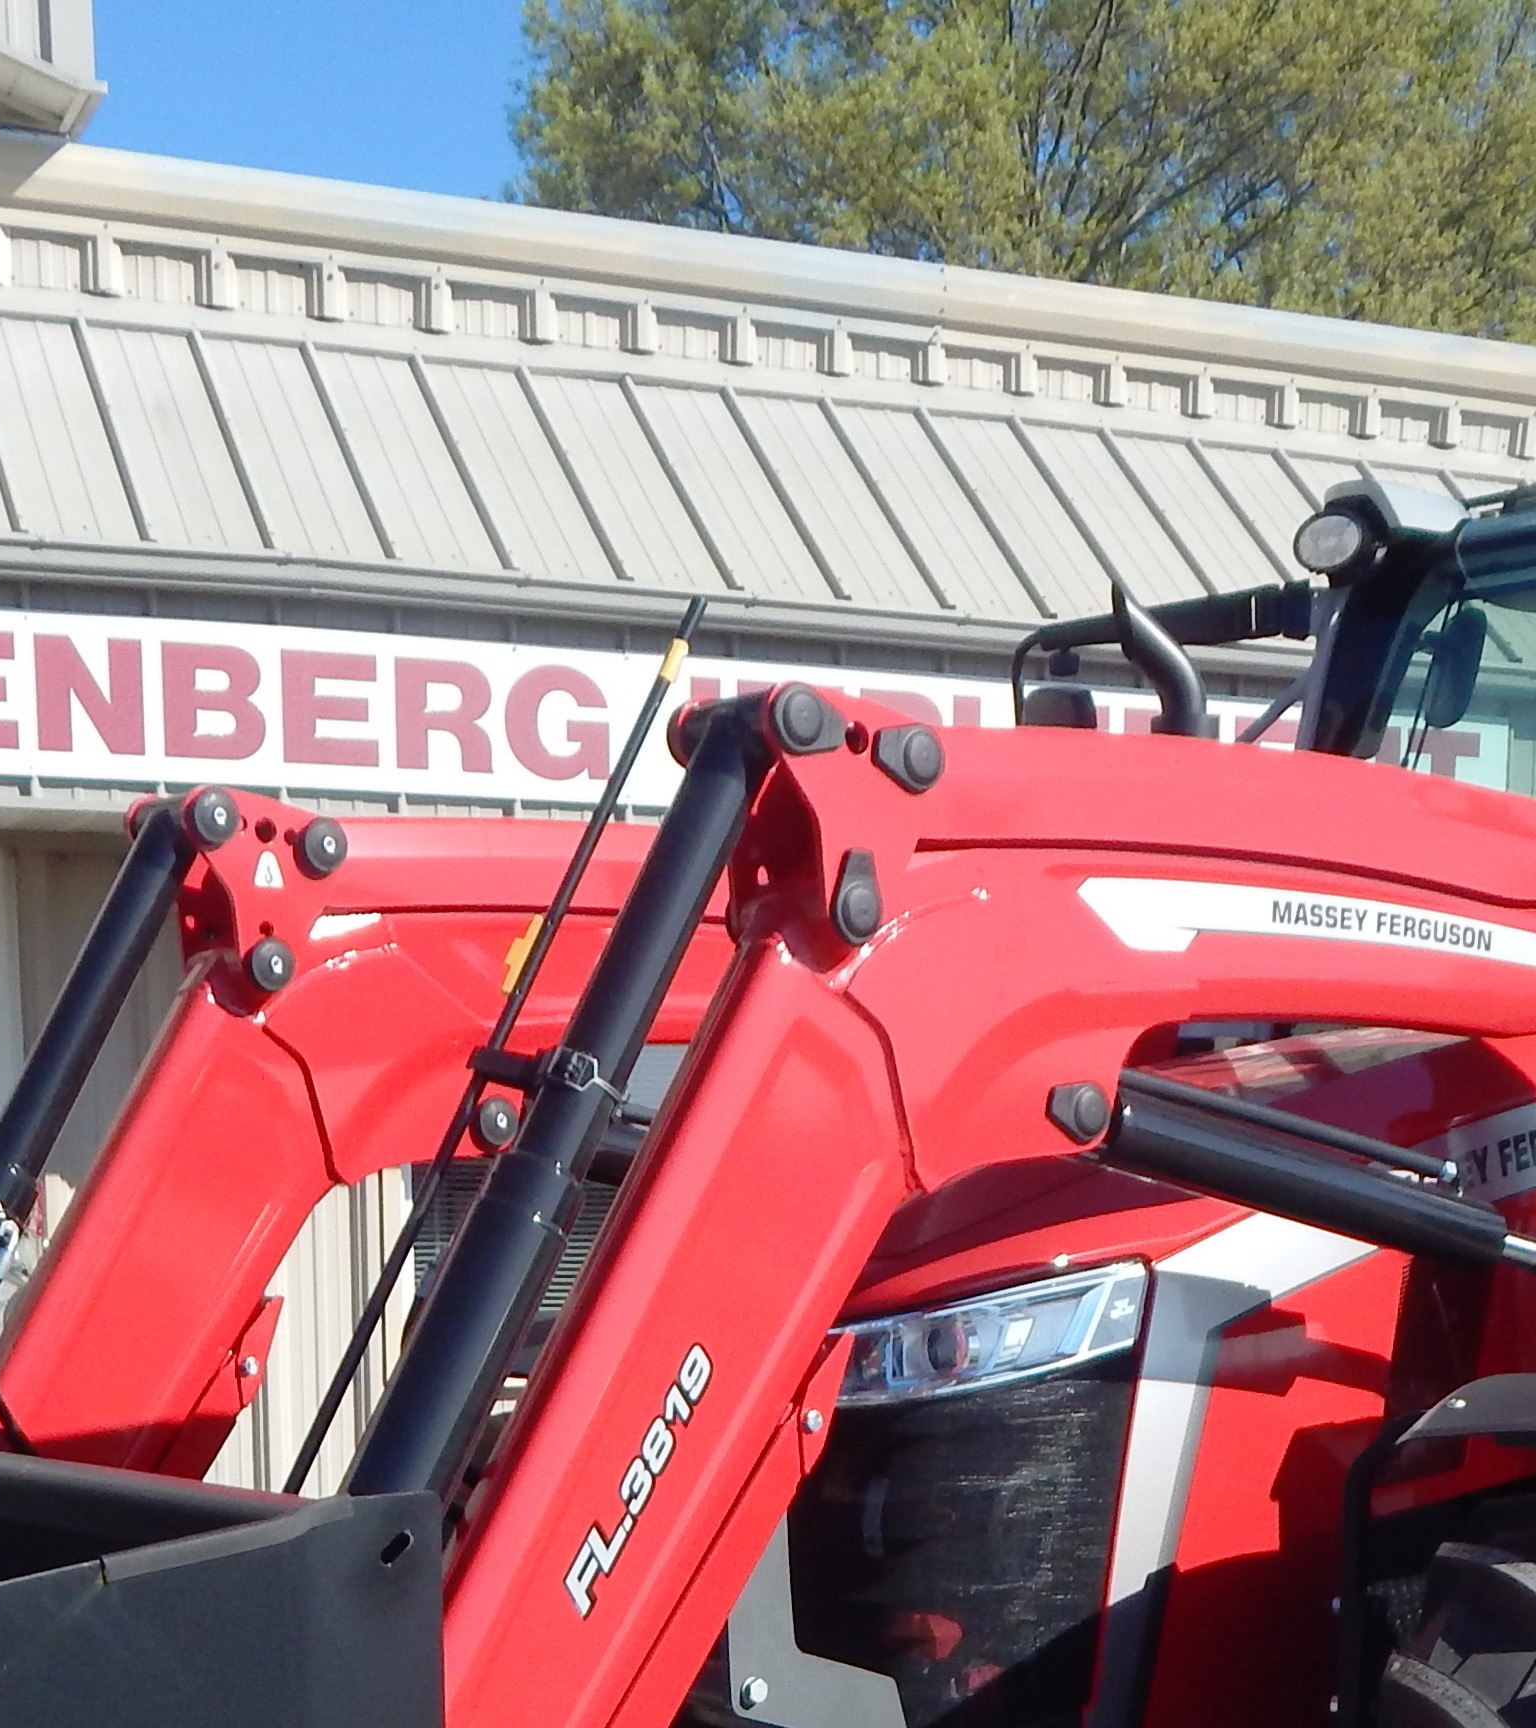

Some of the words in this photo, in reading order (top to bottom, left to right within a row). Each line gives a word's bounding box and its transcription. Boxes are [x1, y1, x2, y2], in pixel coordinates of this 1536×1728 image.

[1272, 900, 1368, 932] MASSEY
[1376, 911, 1493, 951] FERGUSON
[563, 1341, 714, 1620] FL.3819
